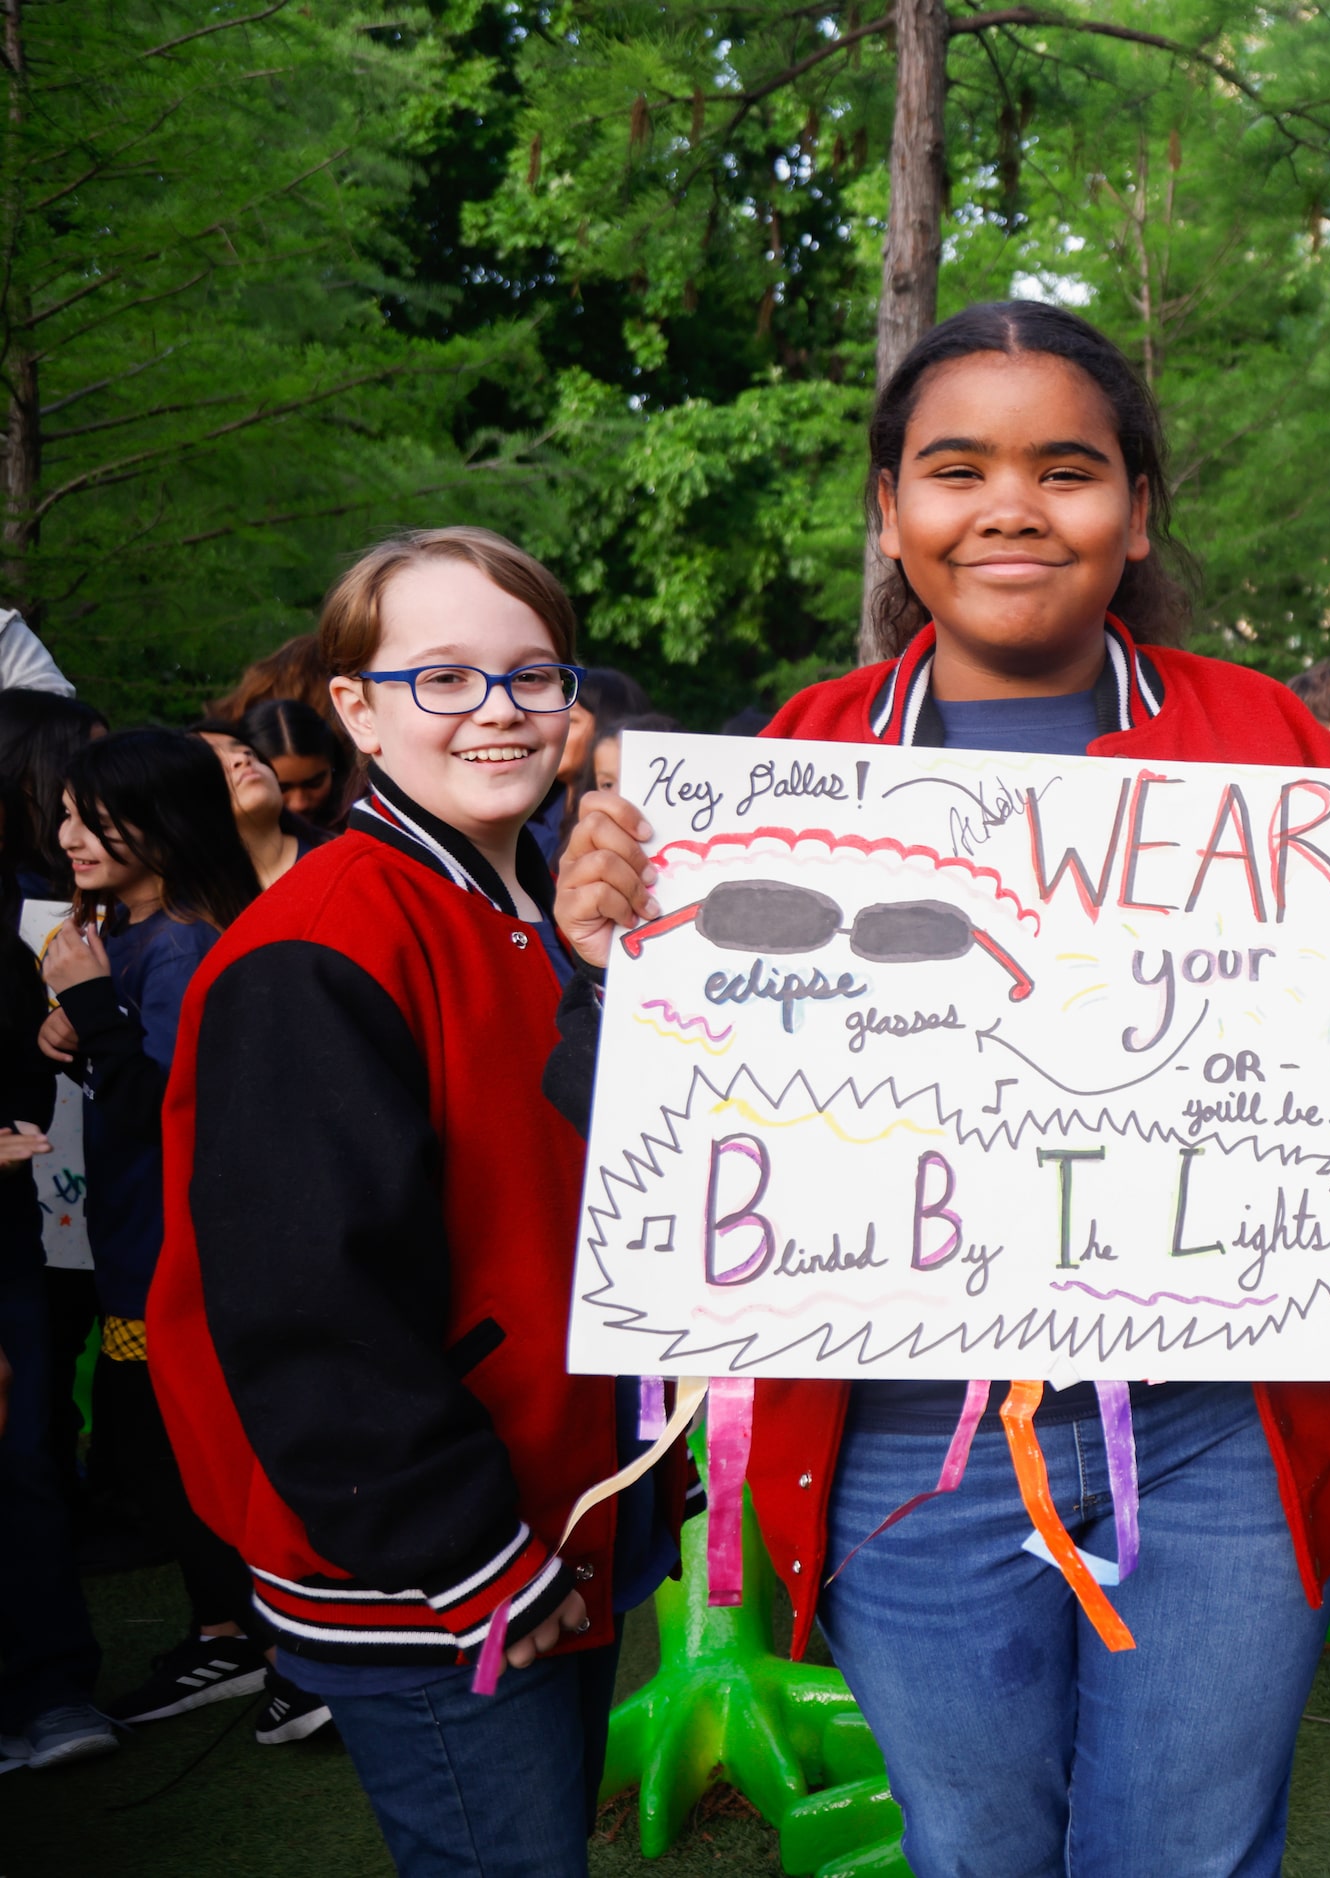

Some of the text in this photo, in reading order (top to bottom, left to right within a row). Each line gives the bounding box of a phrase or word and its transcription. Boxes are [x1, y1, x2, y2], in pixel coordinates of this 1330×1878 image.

[643, 756, 871, 832] Hey Dallas!
[1122, 946, 1277, 1053] your
[705, 1132, 889, 1287] Blinded
[910, 1150, 1004, 1296] By
[1036, 1145, 1118, 1269] The
